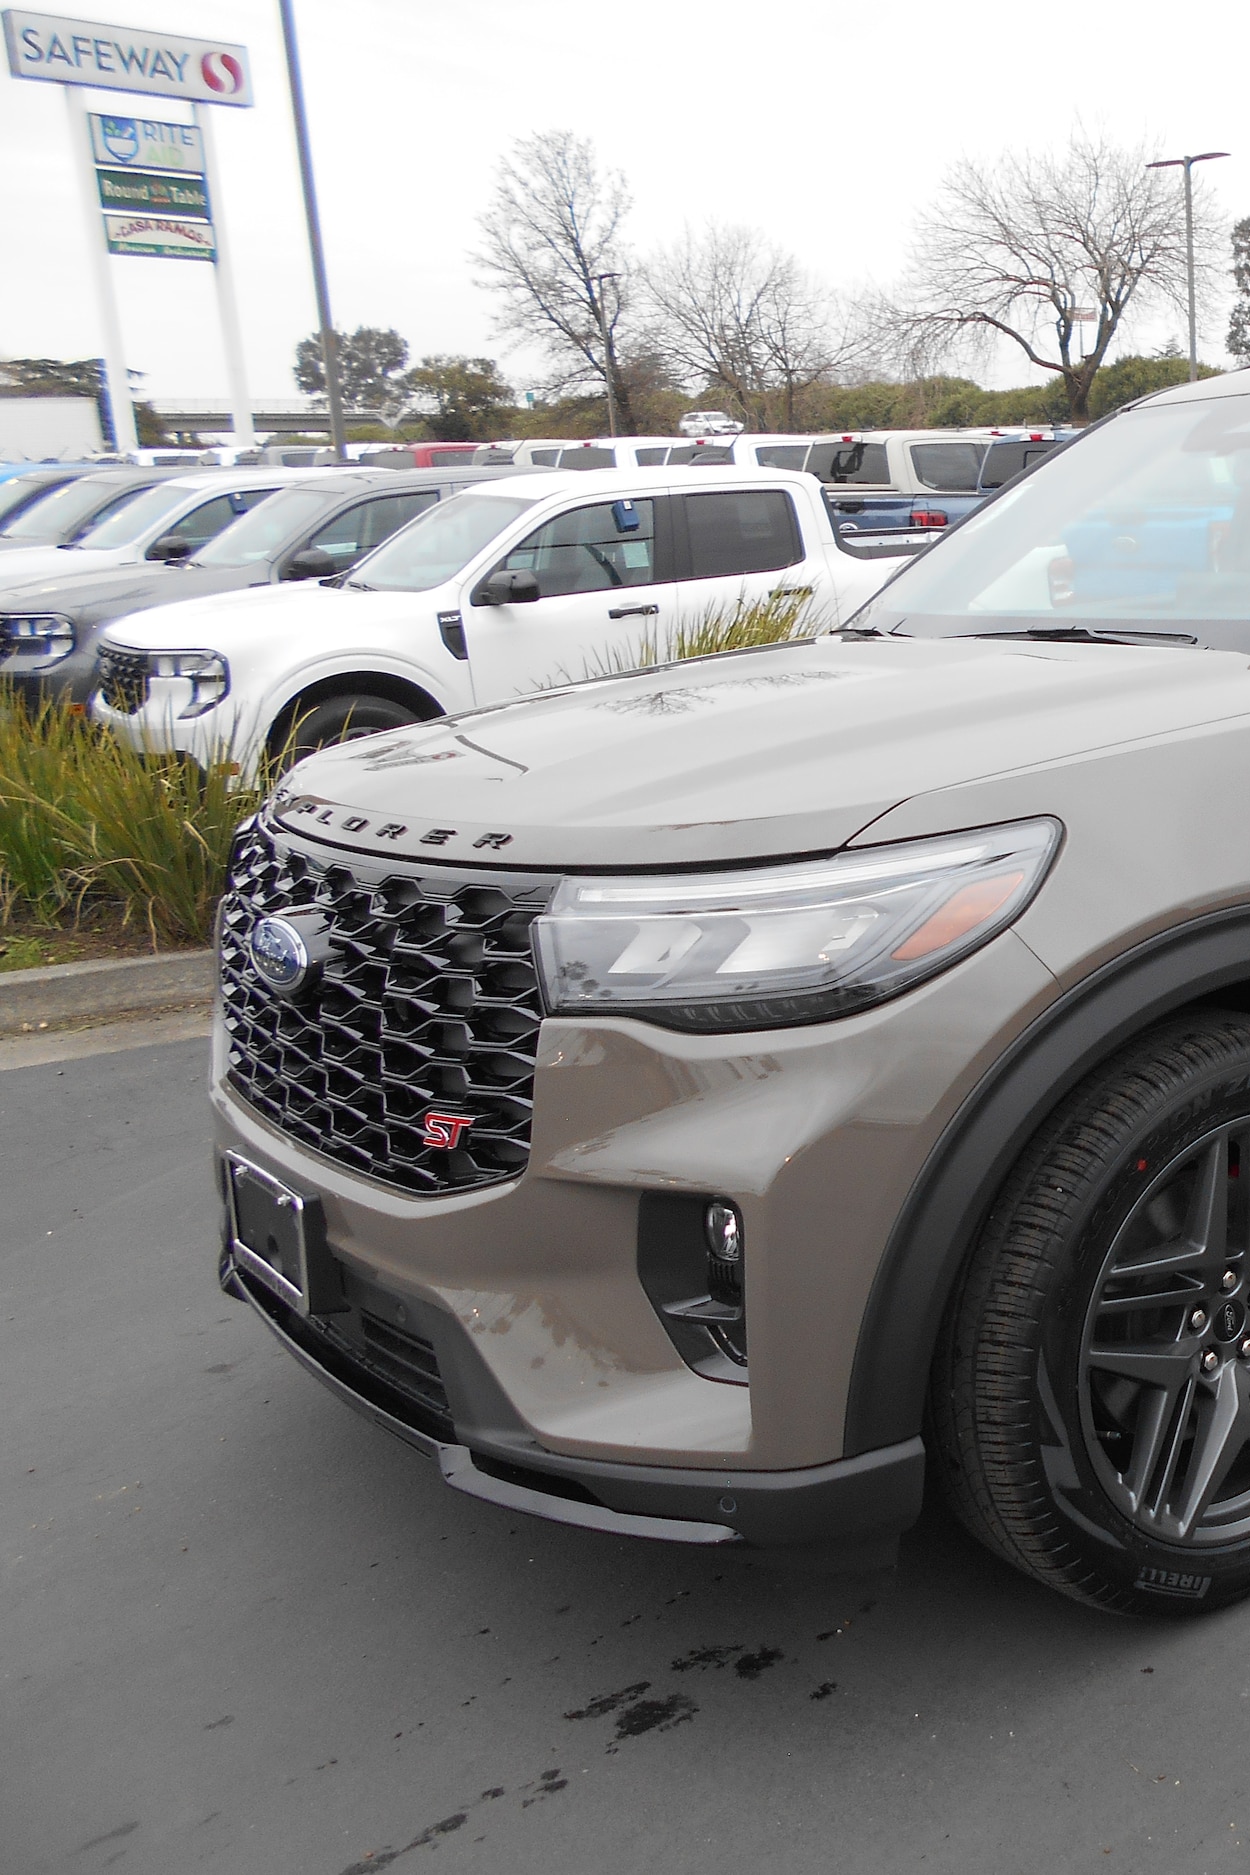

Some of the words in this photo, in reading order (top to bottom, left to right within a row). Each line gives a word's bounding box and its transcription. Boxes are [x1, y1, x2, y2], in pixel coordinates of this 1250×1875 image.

[22, 28, 190, 82] SAFEWAY
[142, 121, 195, 146] RITE
[103, 179, 149, 200] Round
[169, 186, 207, 206] Table
[120, 220, 153, 238] CASA
[157, 220, 203, 244] RAMOS
[423, 1111, 475, 1150] ST
[1134, 1566, 1213, 1598] PIRELLI
